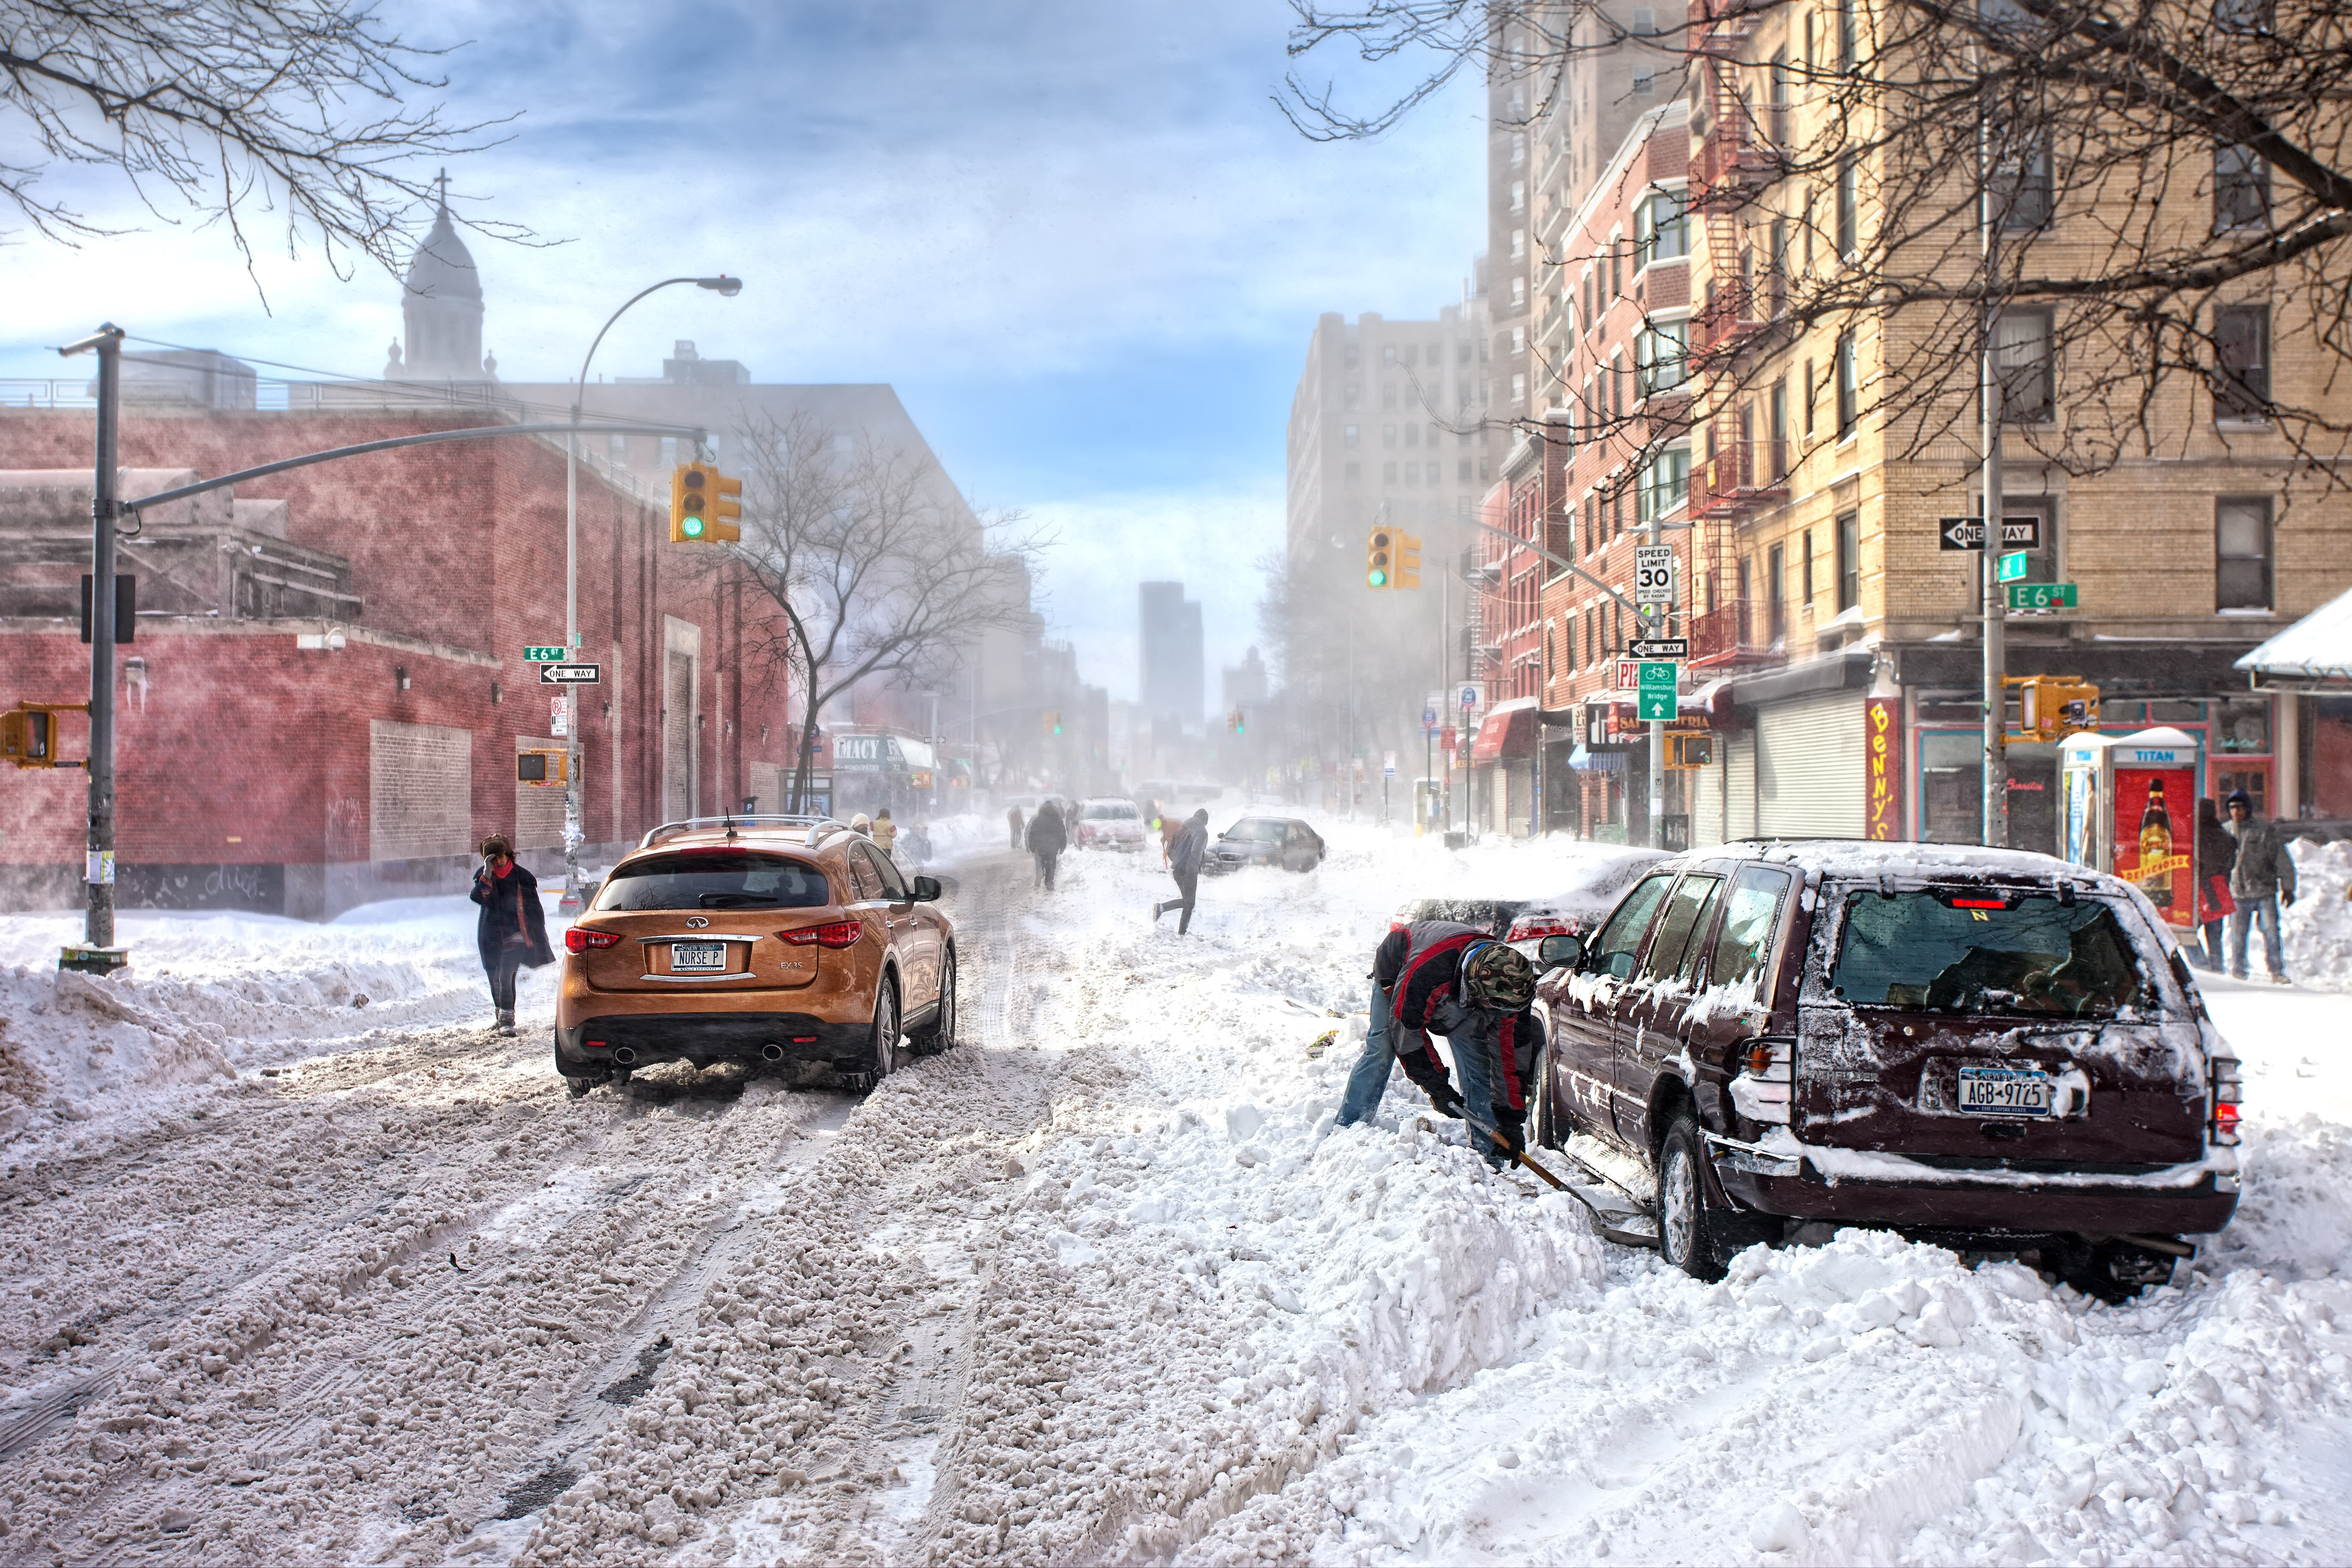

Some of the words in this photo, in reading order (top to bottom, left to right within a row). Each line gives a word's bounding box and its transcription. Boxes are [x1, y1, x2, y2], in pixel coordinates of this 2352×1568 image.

[1954, 527, 1984, 540] ONE
[1638, 549, 1670, 558] SPEED
[1641, 559, 1666, 567] LIMIT
[1639, 569, 1668, 587] 30
[2017, 588, 2029, 606] E
[2035, 588, 2048, 606] 6
[2052, 586, 2065, 597] ST
[530, 648, 538, 660] E
[540, 648, 548, 660] 6
[2135, 750, 2175, 762] TITAN
[679, 952, 707, 964] NURSE
[713, 951, 718, 964] P
